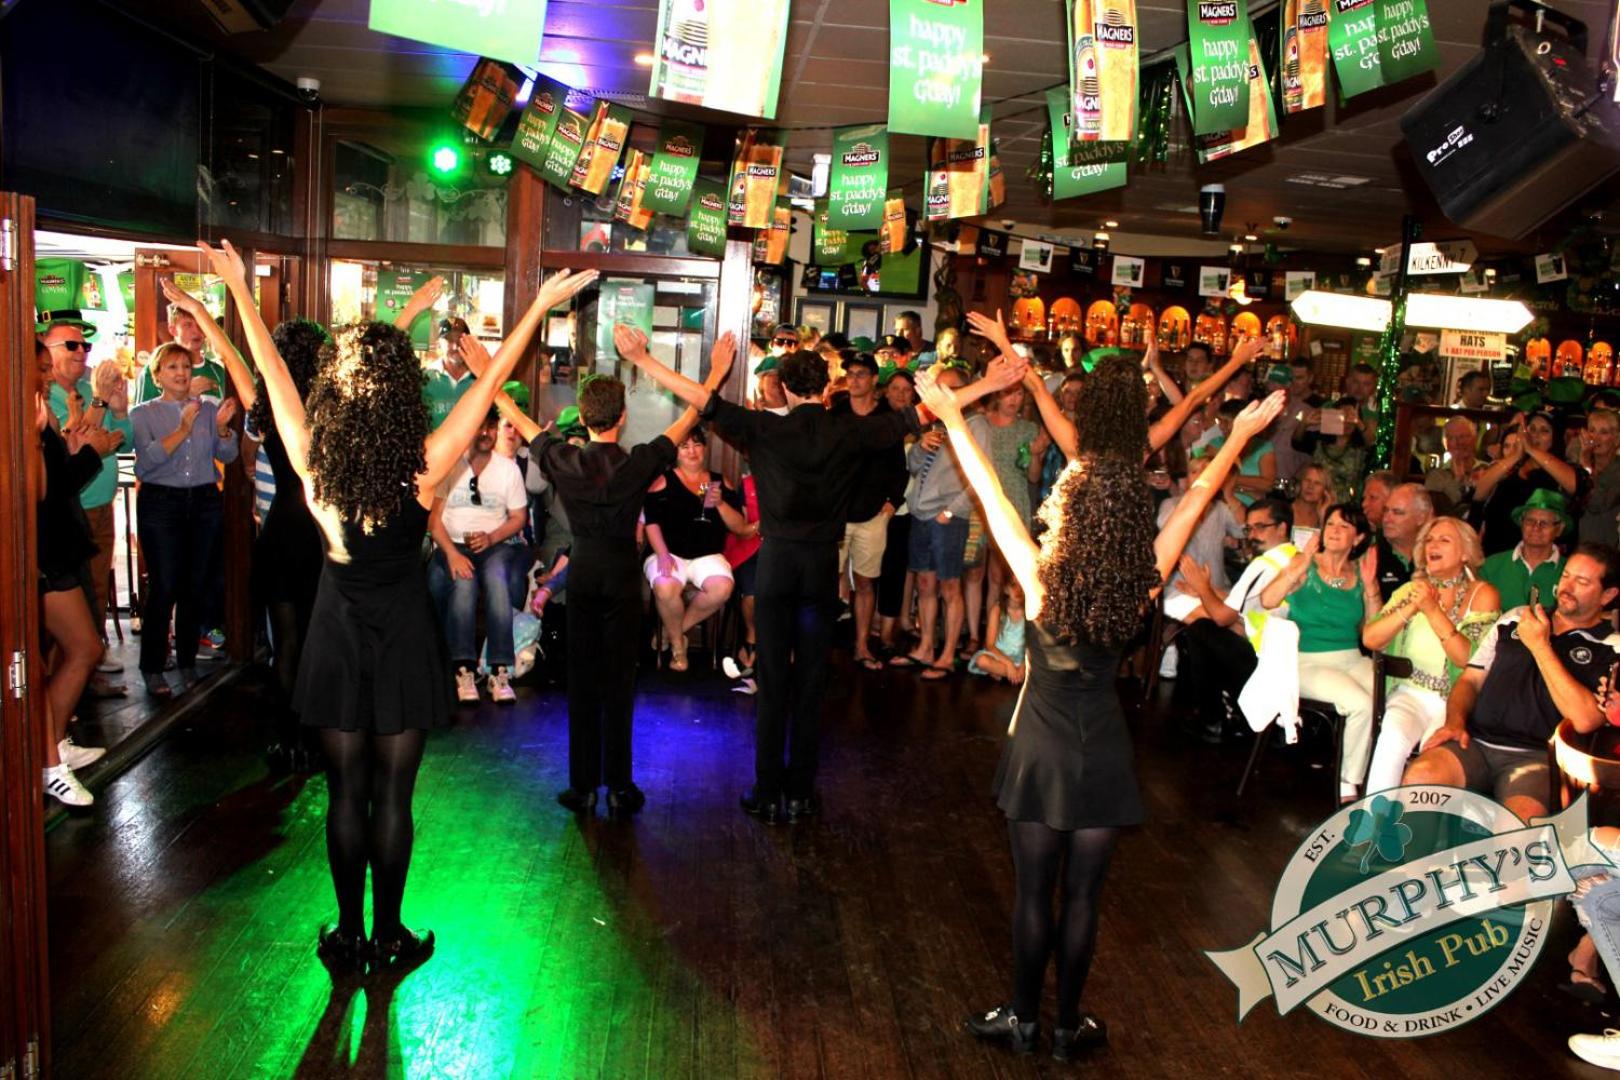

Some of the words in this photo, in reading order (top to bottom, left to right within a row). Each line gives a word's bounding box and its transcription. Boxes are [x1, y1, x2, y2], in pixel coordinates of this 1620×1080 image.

[1201, 4, 1235, 18] MAGNERS
[1383, 0, 1414, 20] happy
[1298, 13, 1326, 28] MAGNERS
[1344, 15, 1376, 37] hap
[1391, 14, 1430, 43] paddy's
[909, 13, 967, 50] happy
[1096, 24, 1133, 42] MAGNERS
[1202, 38, 1239, 61] happy
[1335, 44, 1357, 61] st.
[893, 44, 915, 69] st.
[918, 49, 982, 82] paddy's
[1194, 65, 1210, 83] st.
[1211, 60, 1250, 87] paddy's
[666, 143, 692, 155] MAGNERS
[949, 148, 984, 161] MAGNERS
[1427, 142, 1449, 163] Pro
[845, 153, 877, 163] MAGNERS
[660, 160, 689, 177] happy
[749, 167, 775, 176] MAGNERS
[660, 176, 692, 191] paddy's
[841, 174, 875, 189] happy
[831, 190, 844, 200] st.
[845, 187, 886, 203] paddy's
[698, 211, 720, 226] happy
[1460, 335, 1486, 347] HATS
